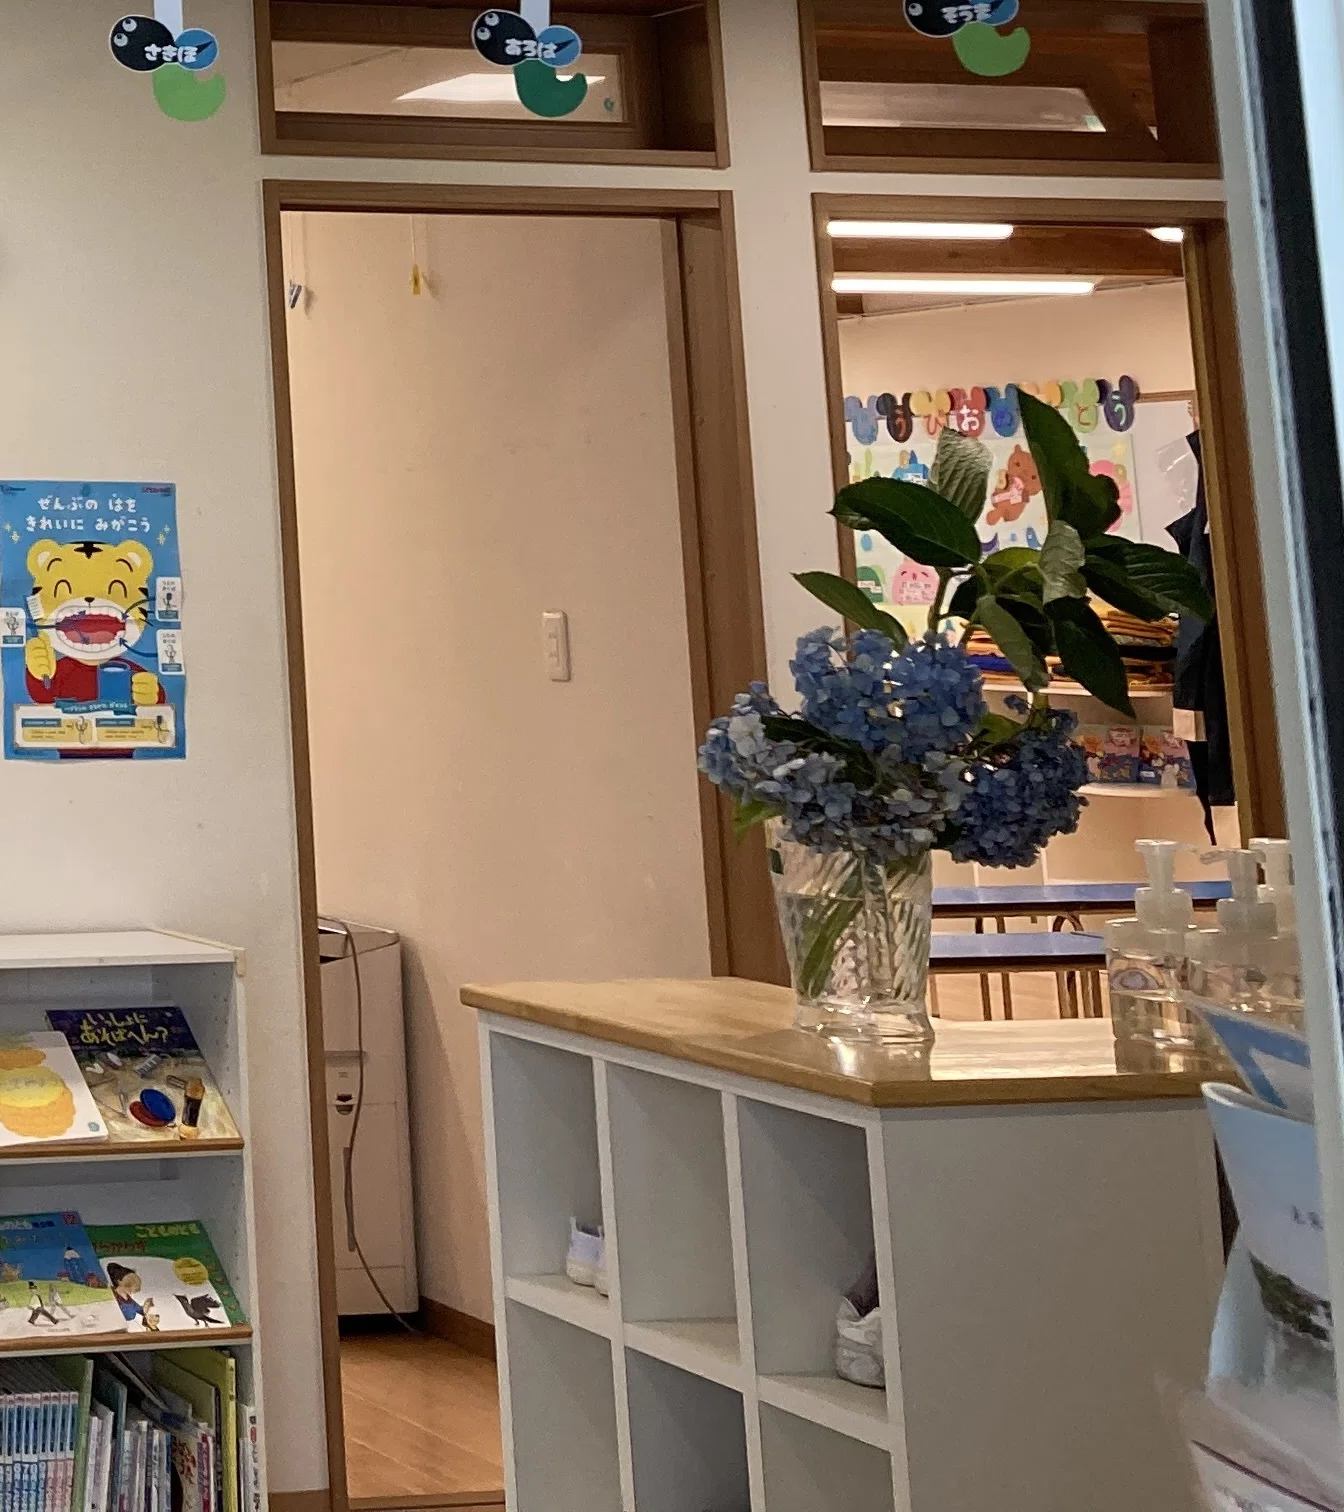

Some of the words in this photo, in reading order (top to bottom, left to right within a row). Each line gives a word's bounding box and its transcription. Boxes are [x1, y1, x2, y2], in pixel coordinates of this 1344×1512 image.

[144, 43, 199, 64] さきほ
[36, 495, 99, 512] ぜんぶの
[107, 492, 138, 513] はを
[25, 515, 85, 533] きれいに
[94, 514, 152, 534] みがこう
[82, 1012, 149, 1028] いっしょに
